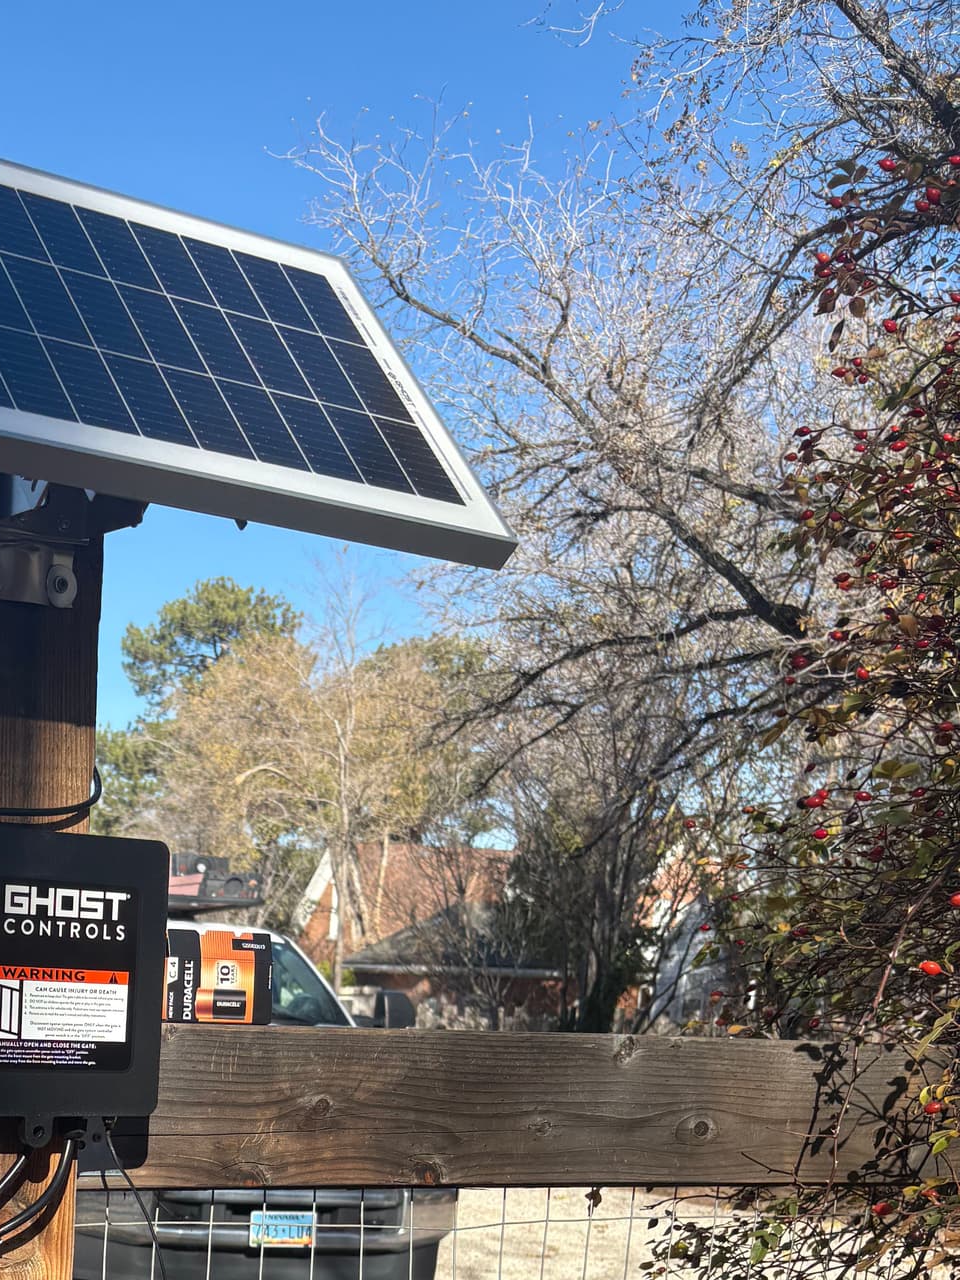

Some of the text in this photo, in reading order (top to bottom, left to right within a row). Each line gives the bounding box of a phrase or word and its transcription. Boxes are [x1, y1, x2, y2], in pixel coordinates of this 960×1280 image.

[4, 884, 127, 920] GHOST
[4, 918, 125, 940] CONTROLS
[2, 967, 86, 982] WARNING
[220, 965, 230, 984] 10
[182, 961, 193, 1020] DURACELL
